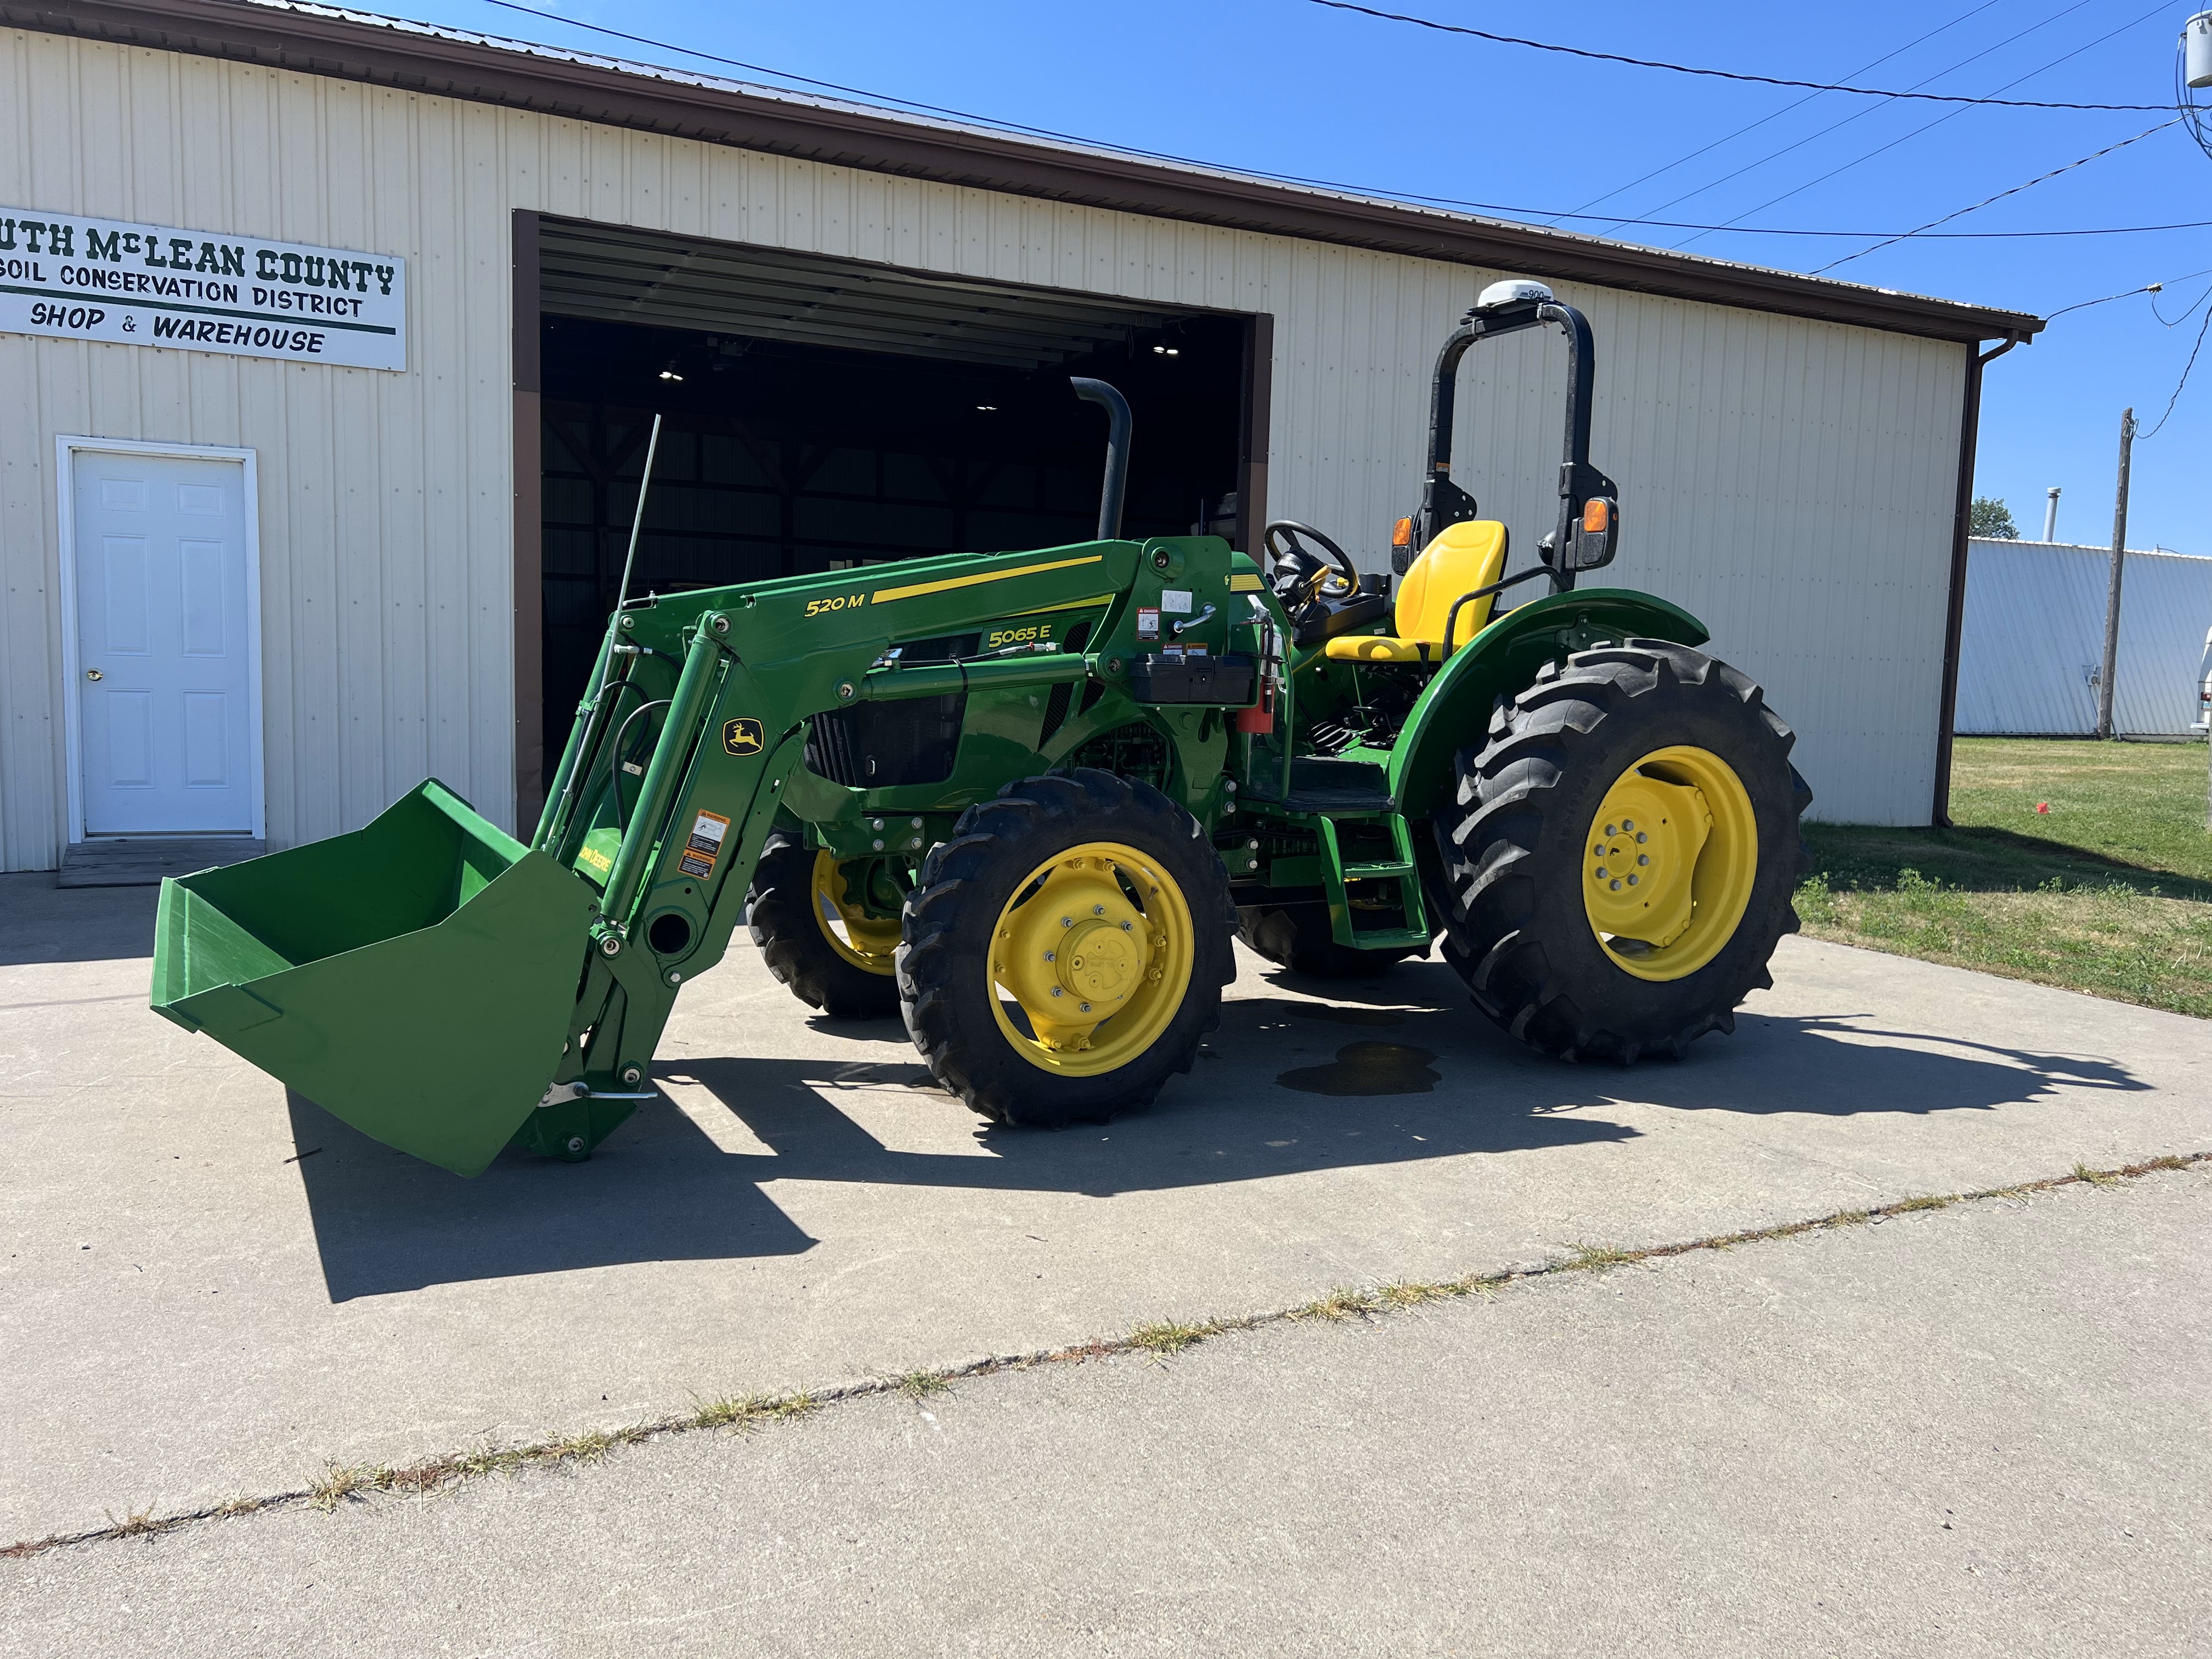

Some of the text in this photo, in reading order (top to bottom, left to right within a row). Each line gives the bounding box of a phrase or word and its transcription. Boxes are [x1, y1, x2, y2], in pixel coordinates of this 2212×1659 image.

[256, 250, 394, 295] COUNTY
[60, 265, 238, 303] CONSERVATION
[252, 287, 364, 317] DISTRICT
[1528, 289, 1544, 298] 900
[31, 303, 325, 353] SHOP & WAREHOUSE
[804, 594, 865, 617] 520 M
[989, 625, 1052, 647] 5065 E
[707, 813, 726, 823] WARNING
[579, 844, 612, 872] JOHN DEERE
[692, 854, 712, 863] WARNING
